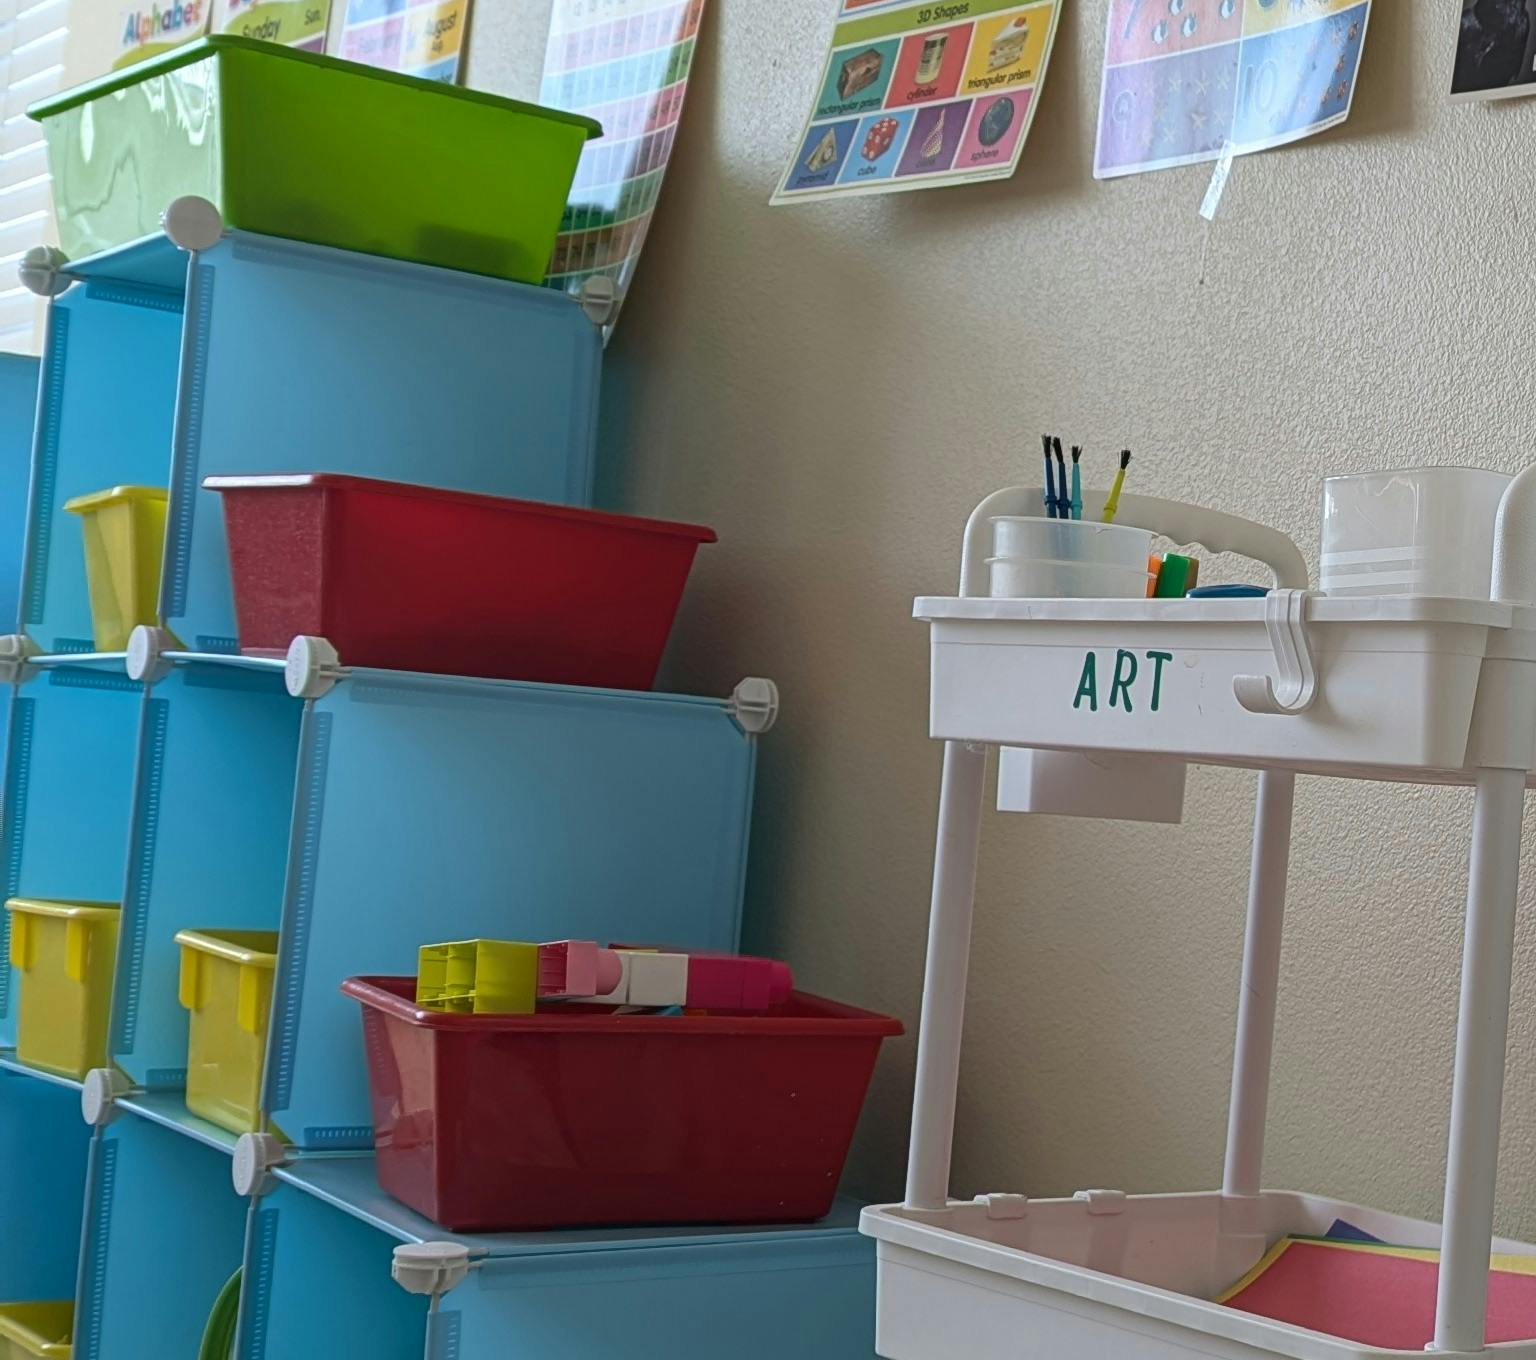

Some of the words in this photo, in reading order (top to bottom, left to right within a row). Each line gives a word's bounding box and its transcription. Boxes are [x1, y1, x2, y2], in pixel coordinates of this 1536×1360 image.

[917, 10, 930, 24] 3D
[933, 2, 969, 21] Shapes
[1007, 69, 1032, 84] prism
[857, 165, 878, 177] cube
[1072, 648, 1174, 713] ART
